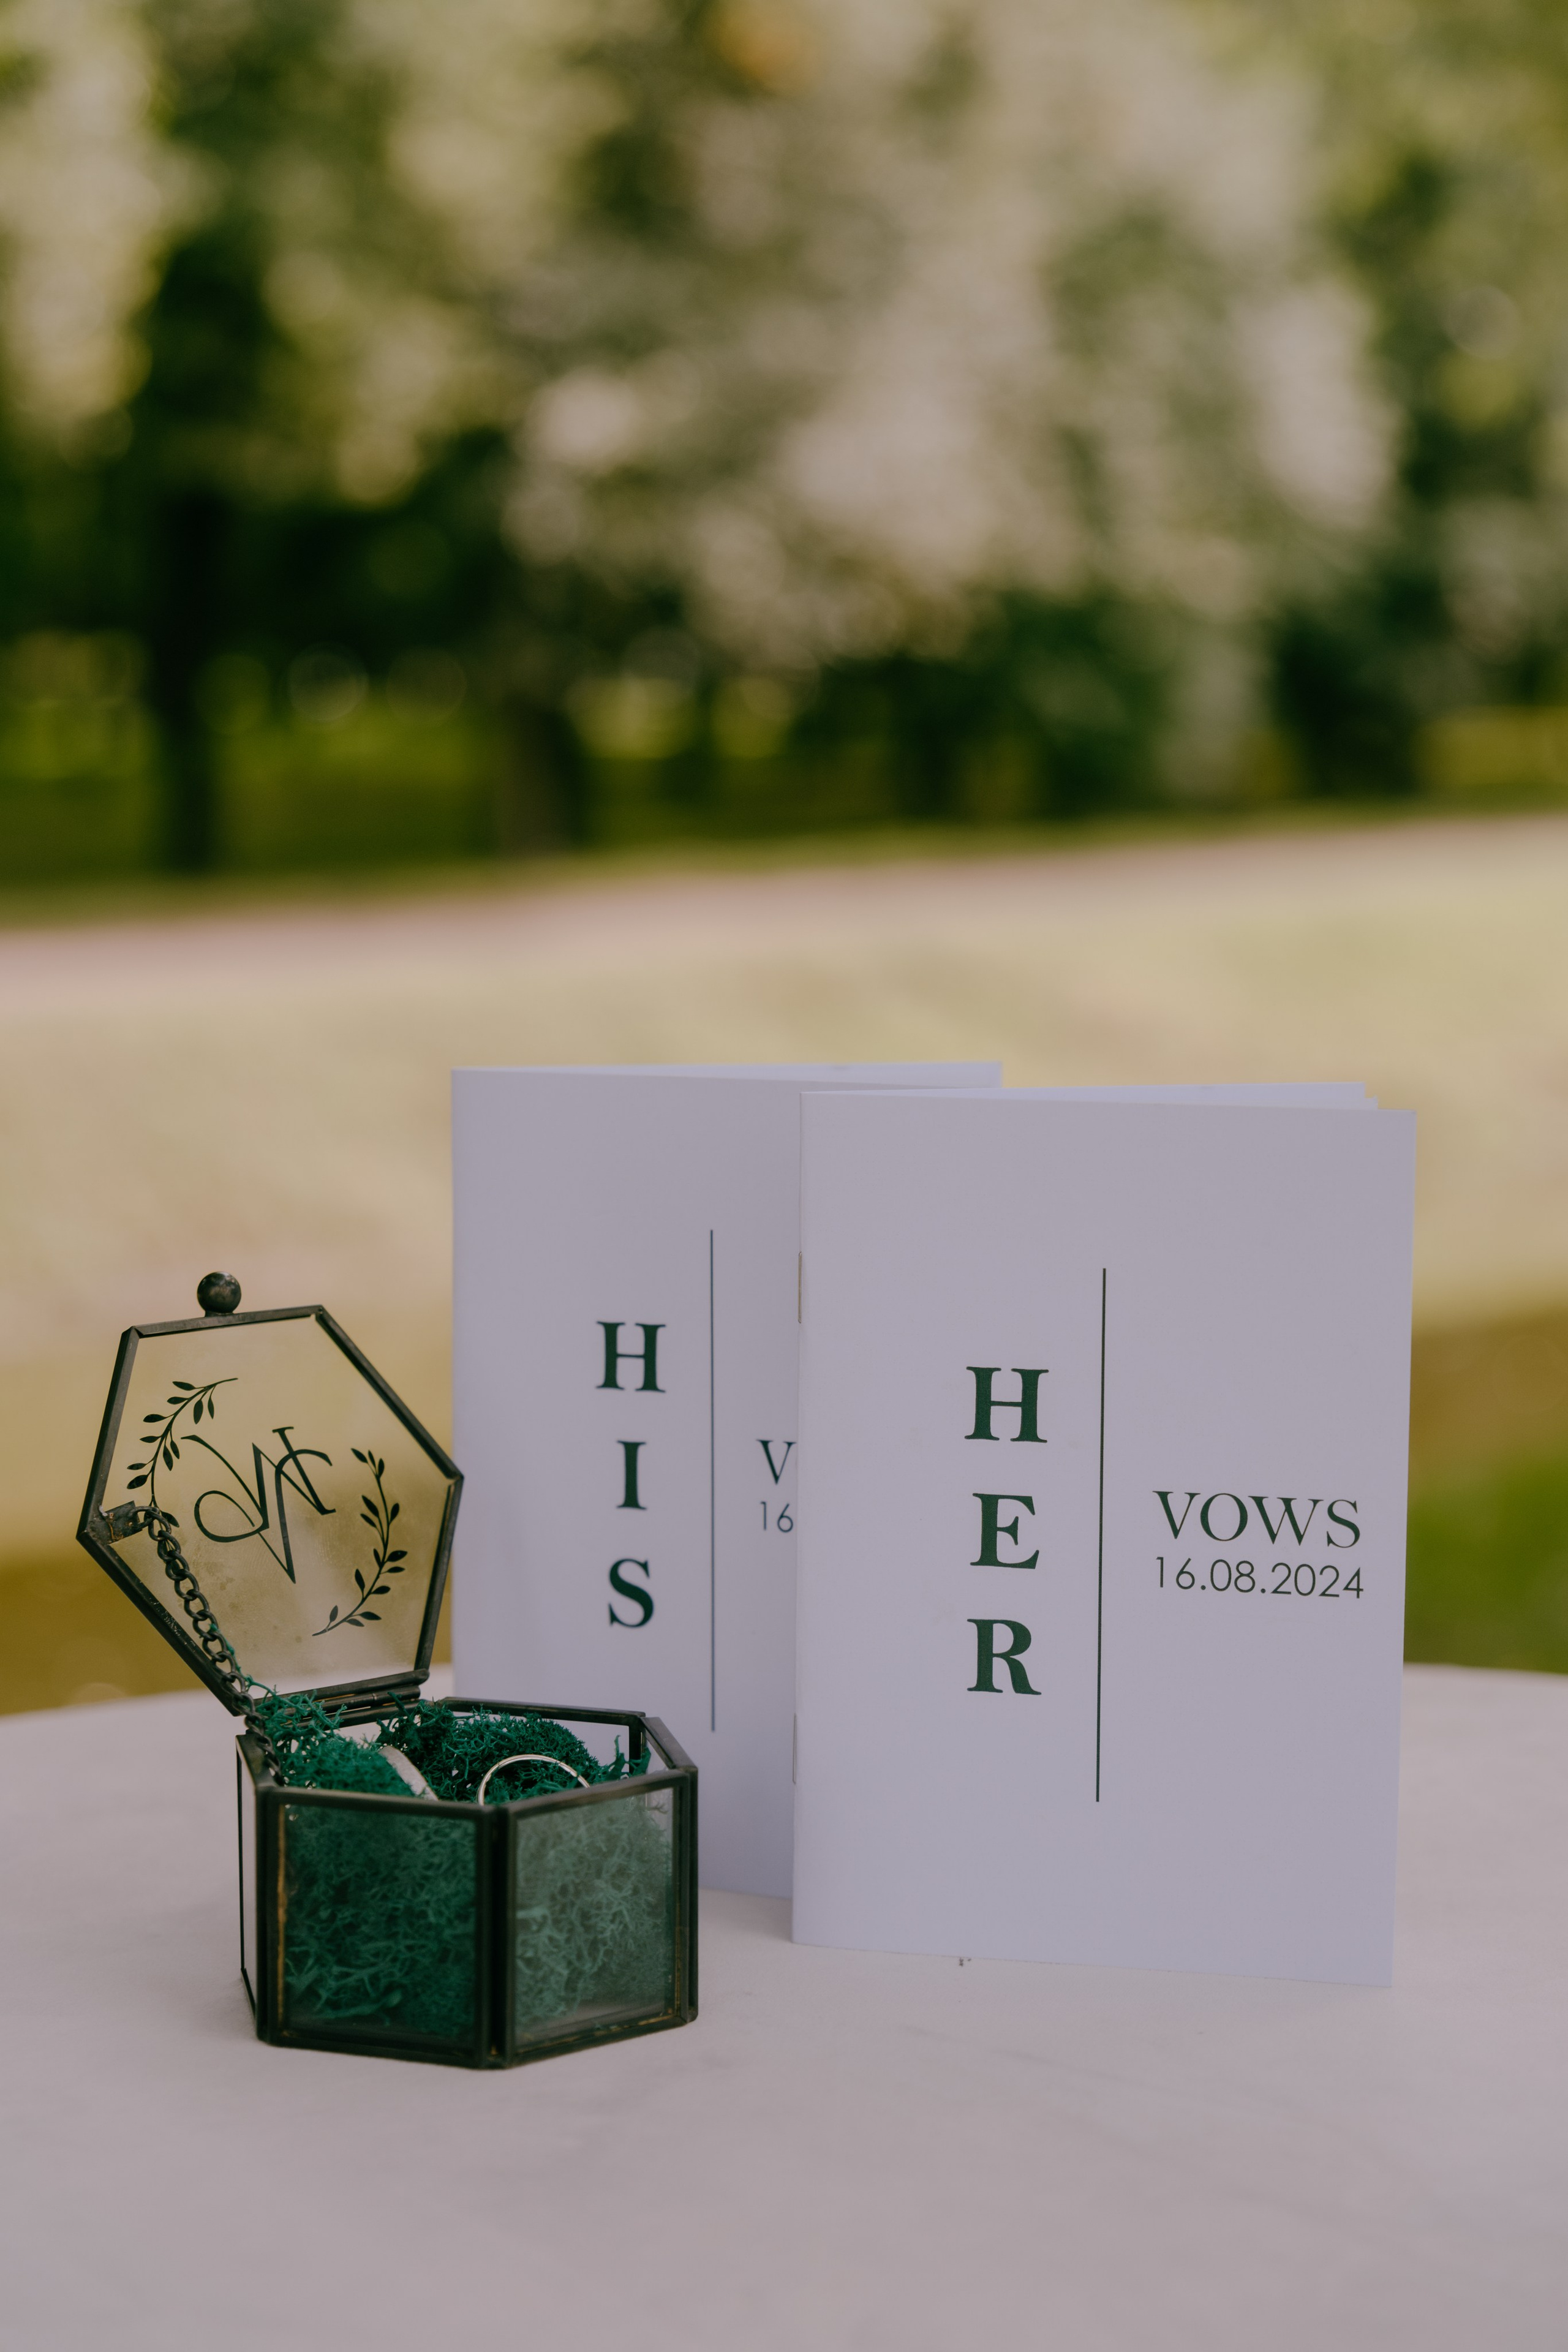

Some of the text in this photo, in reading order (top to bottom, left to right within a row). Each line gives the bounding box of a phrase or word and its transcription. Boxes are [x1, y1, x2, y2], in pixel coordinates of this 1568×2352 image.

[595, 1320, 667, 1629] HIS
[963, 1366, 1050, 1696] HER
[1152, 1490, 1361, 1548] VOWS
[1155, 1556, 1365, 1599] 16.08.2024
